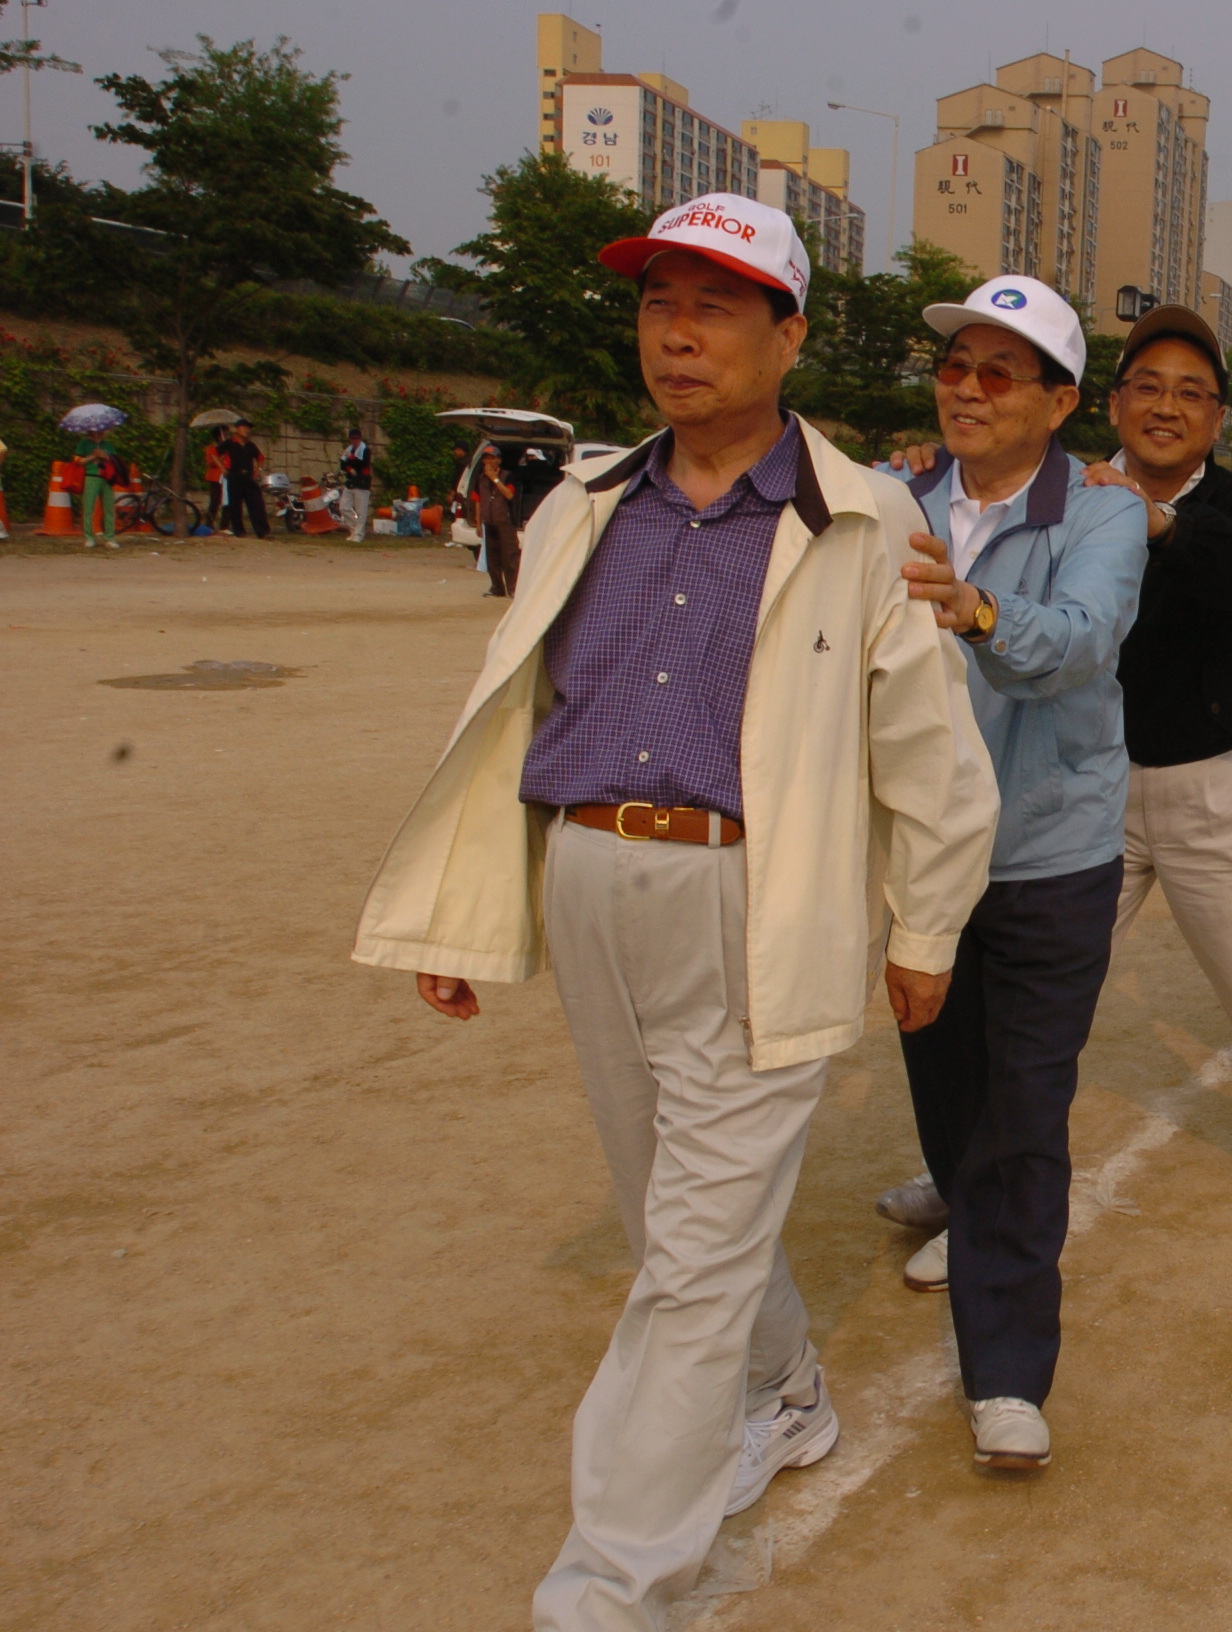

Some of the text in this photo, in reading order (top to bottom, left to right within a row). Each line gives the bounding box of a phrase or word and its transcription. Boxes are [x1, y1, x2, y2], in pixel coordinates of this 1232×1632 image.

[582, 131, 619, 146] 경남
[1110, 141, 1128, 150] 502
[590, 154, 610, 168] 101
[688, 202, 725, 212] GOLF
[948, 203, 967, 214] 501
[657, 211, 756, 244] SUPERIOR
